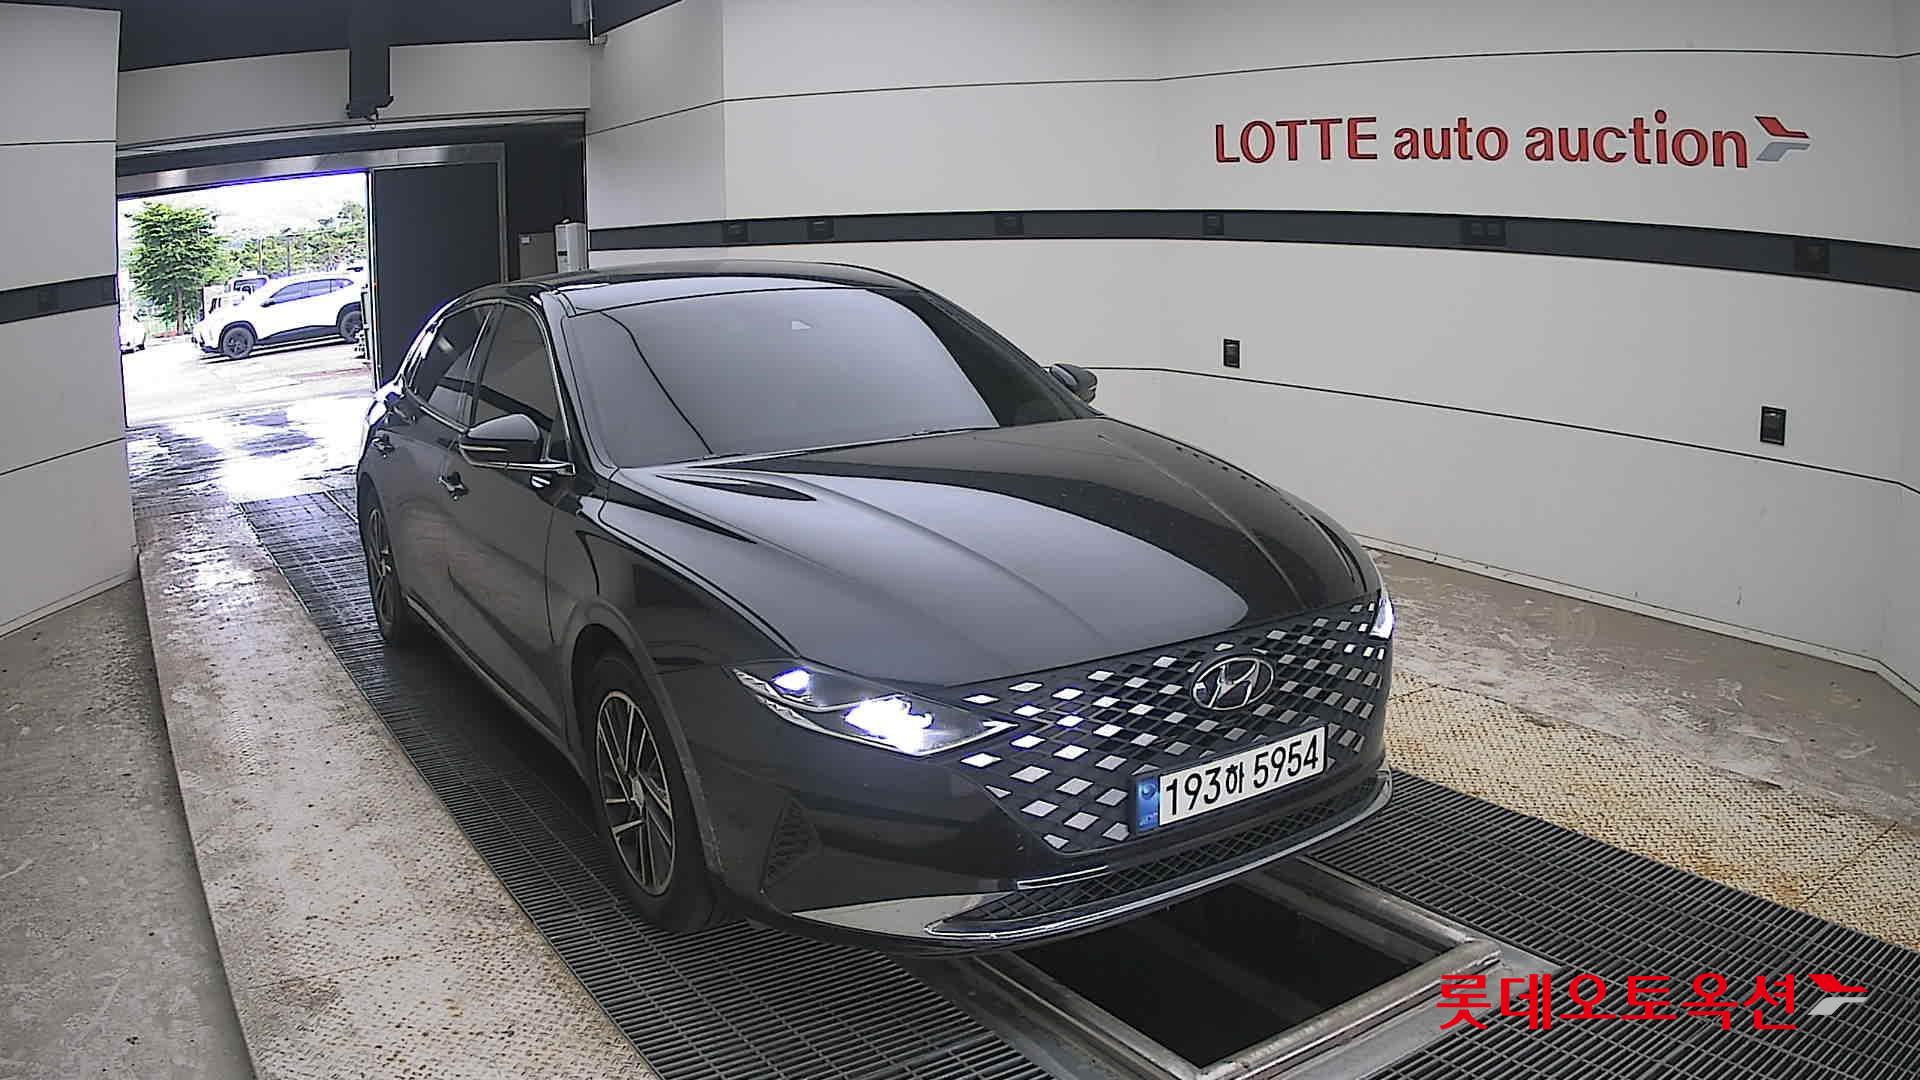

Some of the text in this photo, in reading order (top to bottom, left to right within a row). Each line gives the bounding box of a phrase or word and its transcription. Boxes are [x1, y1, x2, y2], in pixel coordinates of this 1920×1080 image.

[1215, 108, 1748, 169] LOTTE auto auction
[1165, 734, 1319, 816] 193하 5954
